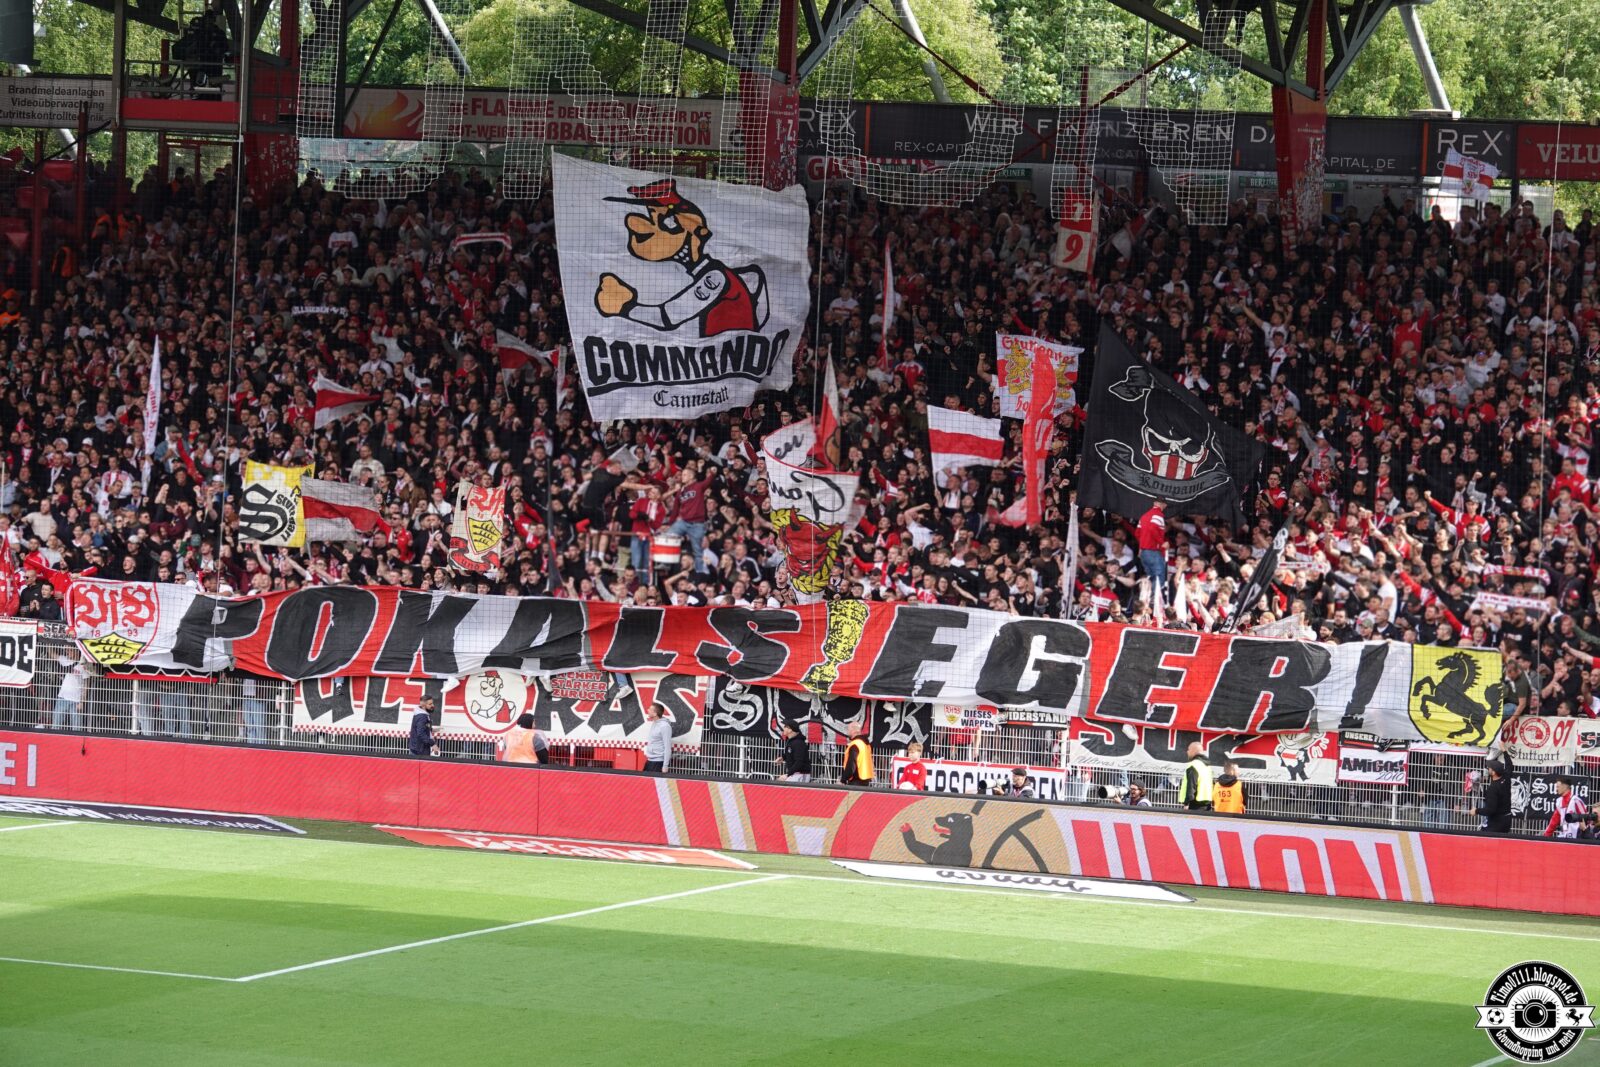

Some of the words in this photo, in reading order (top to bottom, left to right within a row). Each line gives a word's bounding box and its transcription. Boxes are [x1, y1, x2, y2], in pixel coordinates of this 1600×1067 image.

[8, 85, 105, 98] Brandmeldeanlagen
[1437, 129, 1504, 155] REX
[1323, 157, 1396, 169] APITAL.DE
[583, 328, 790, 387] COMMANDO
[653, 385, 729, 409] Cannstatt
[1005, 711, 1068, 725] IDERSTAND
[1508, 745, 1561, 765] Stuttgart
[1217, 789, 1232, 798] 163
